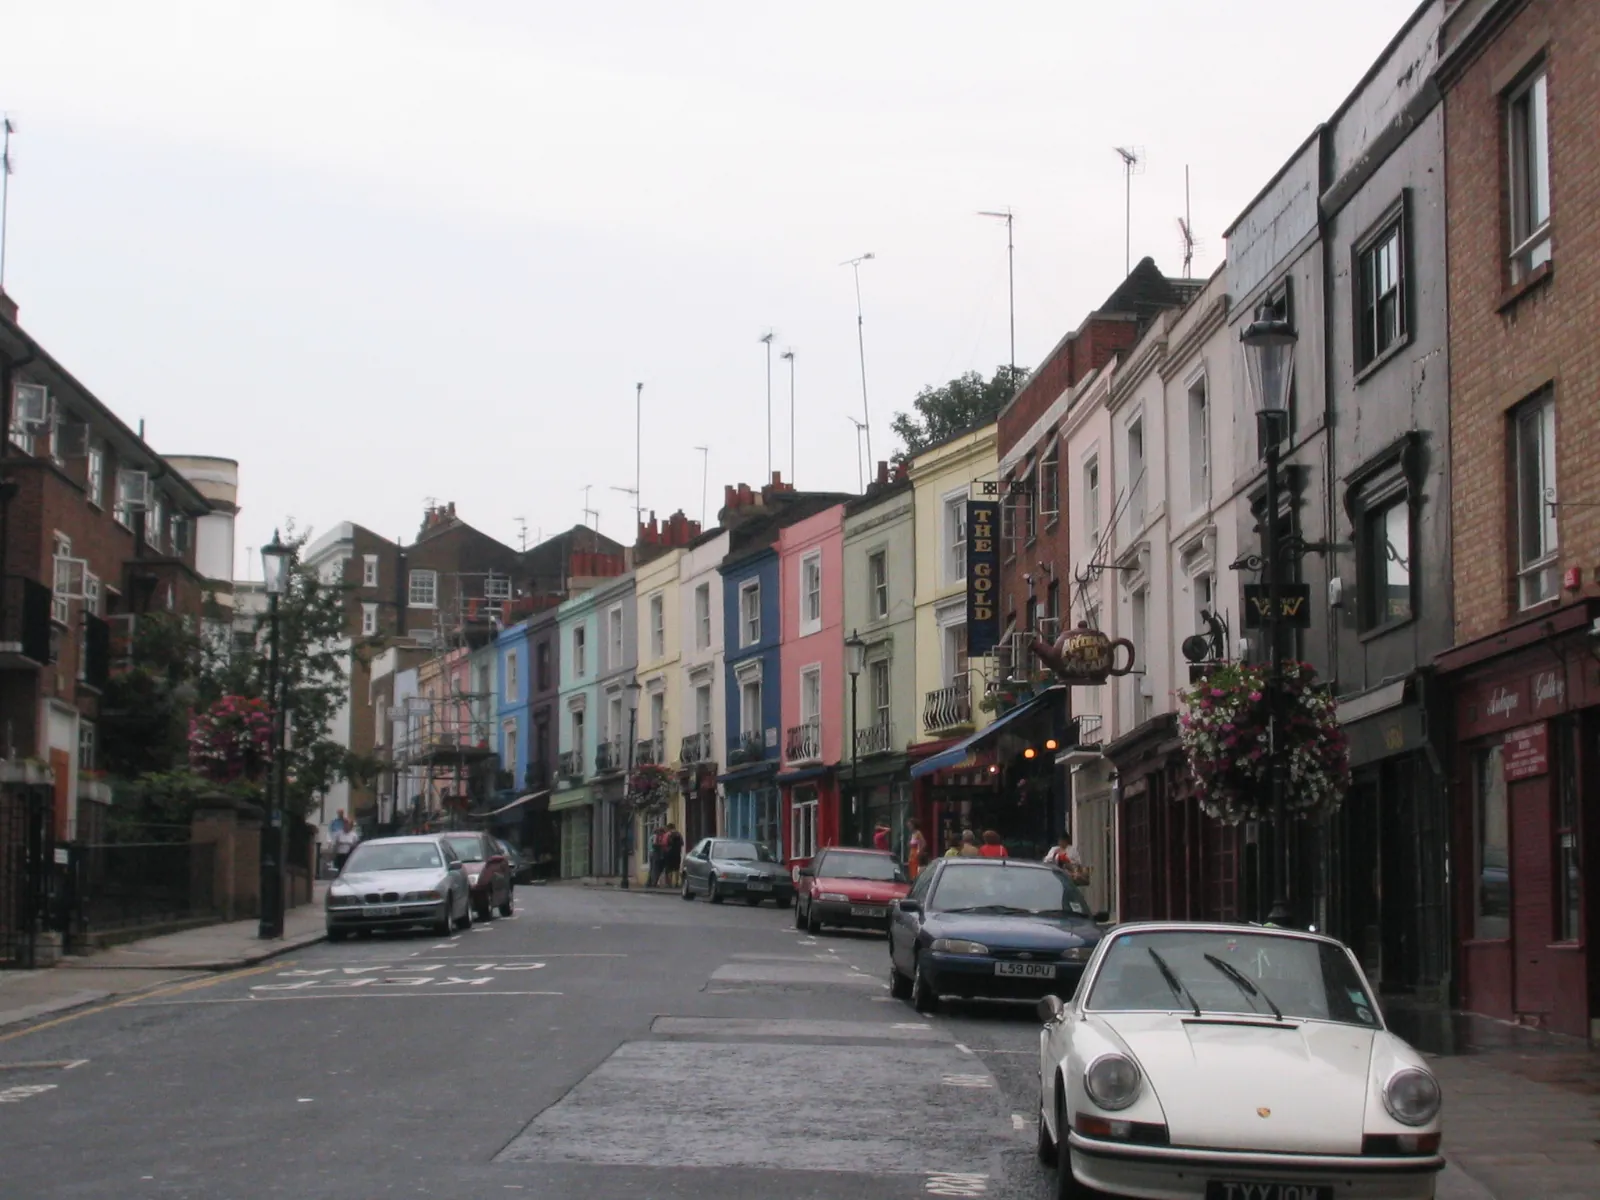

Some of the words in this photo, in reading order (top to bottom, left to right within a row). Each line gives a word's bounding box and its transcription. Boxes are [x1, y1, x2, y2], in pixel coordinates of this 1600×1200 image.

[974, 510, 992, 552] THE
[974, 563, 992, 620] GOLD
[276, 963, 546, 976] CLEAR
[250, 977, 495, 990] KEEP
